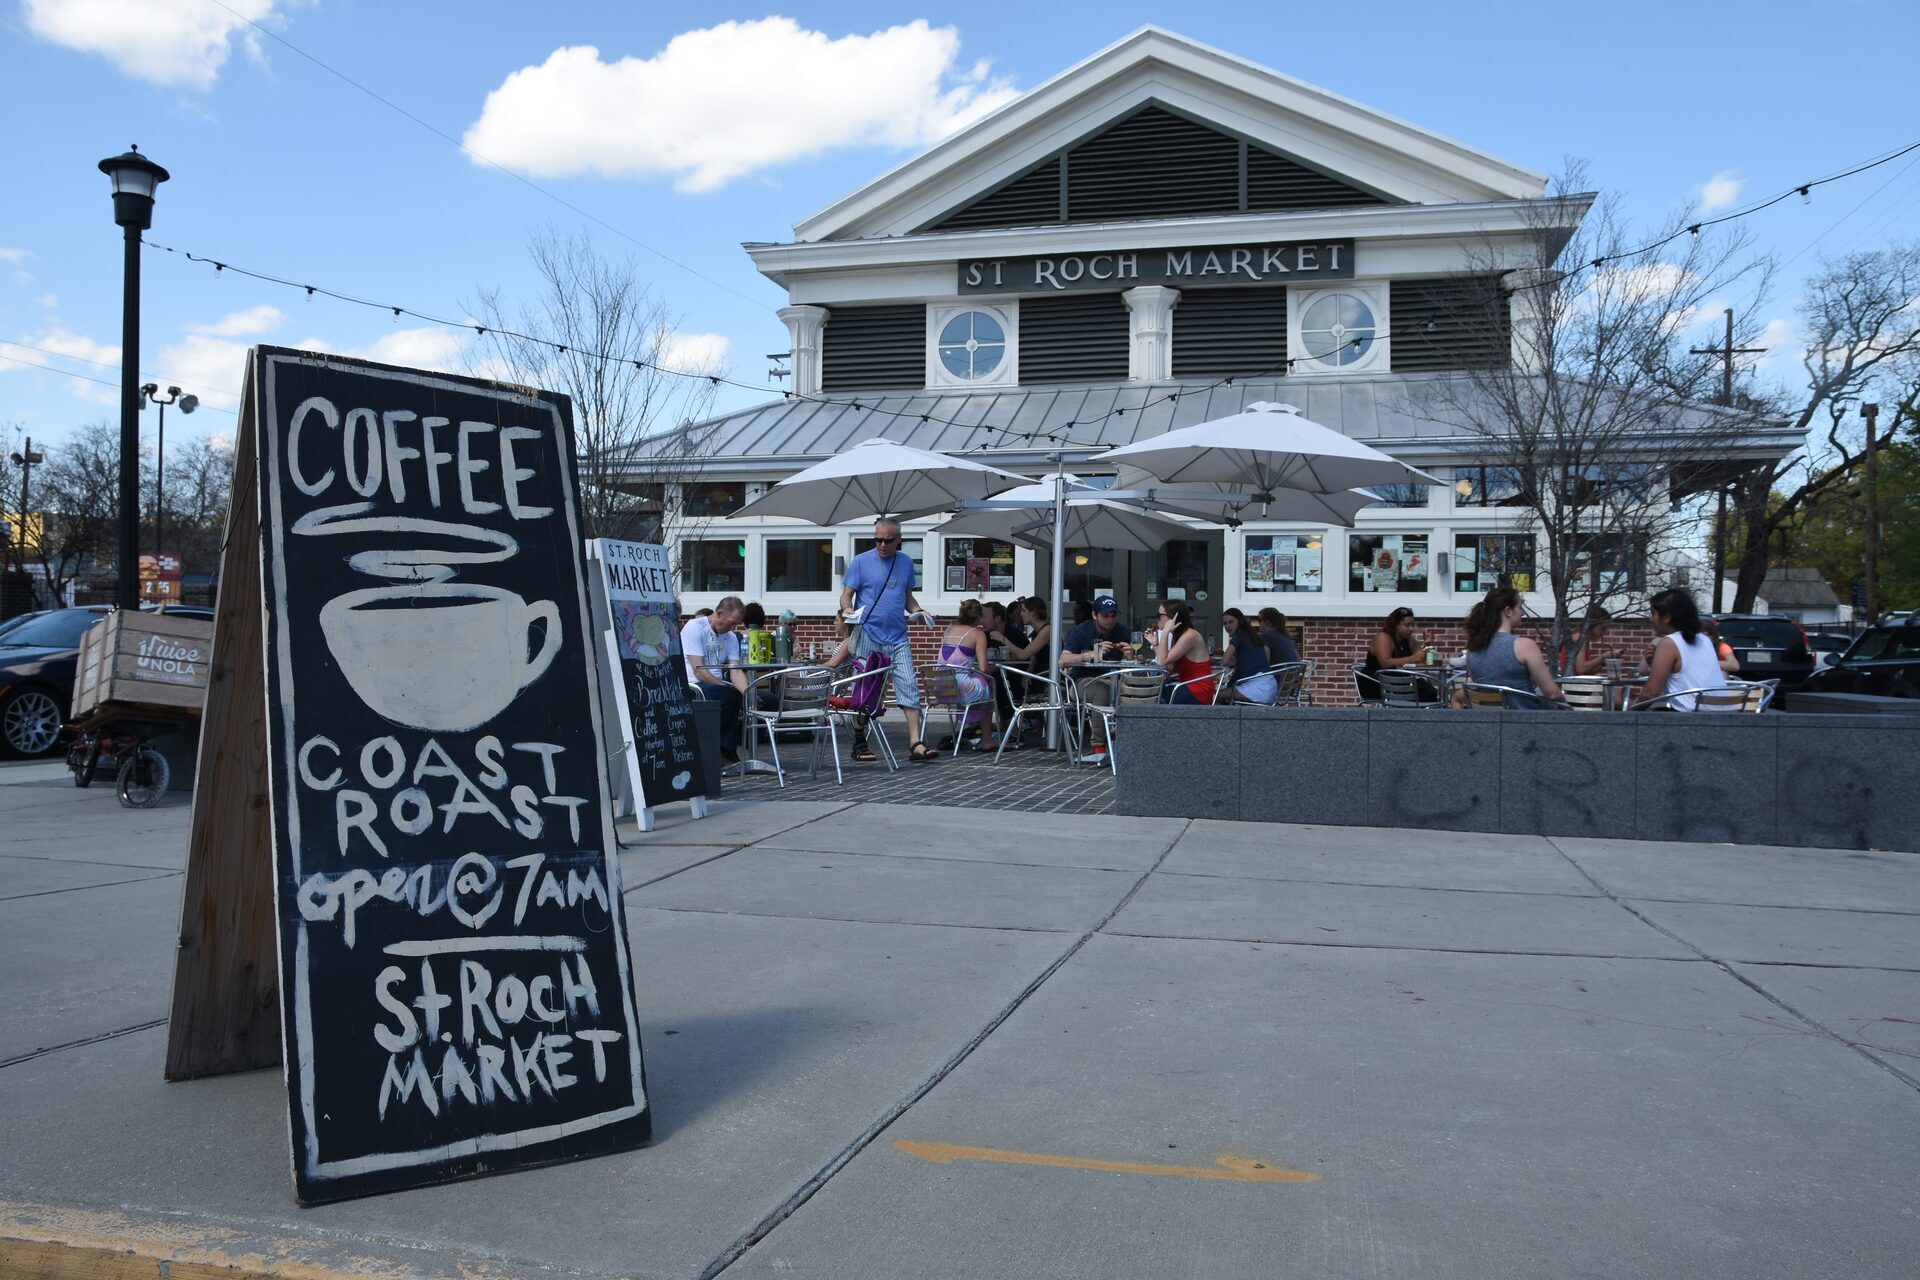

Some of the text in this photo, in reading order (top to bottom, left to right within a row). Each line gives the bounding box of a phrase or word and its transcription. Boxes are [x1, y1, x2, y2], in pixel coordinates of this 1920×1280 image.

[966, 244, 1345, 290] ST ROCH MARKET
[288, 396, 554, 521] COFFEE
[608, 543, 662, 564] ST. ROCH
[607, 563, 668, 599] MARKET
[151, 657, 196, 675] NOLA
[631, 674, 685, 708] Breakfast
[634, 716, 658, 738] Coffee
[667, 716, 687, 734] Crepes
[669, 733, 687, 747] Tacos
[298, 734, 568, 796] COAST
[336, 784, 589, 858] ROAST
[378, 1027, 623, 1123] MARKET
